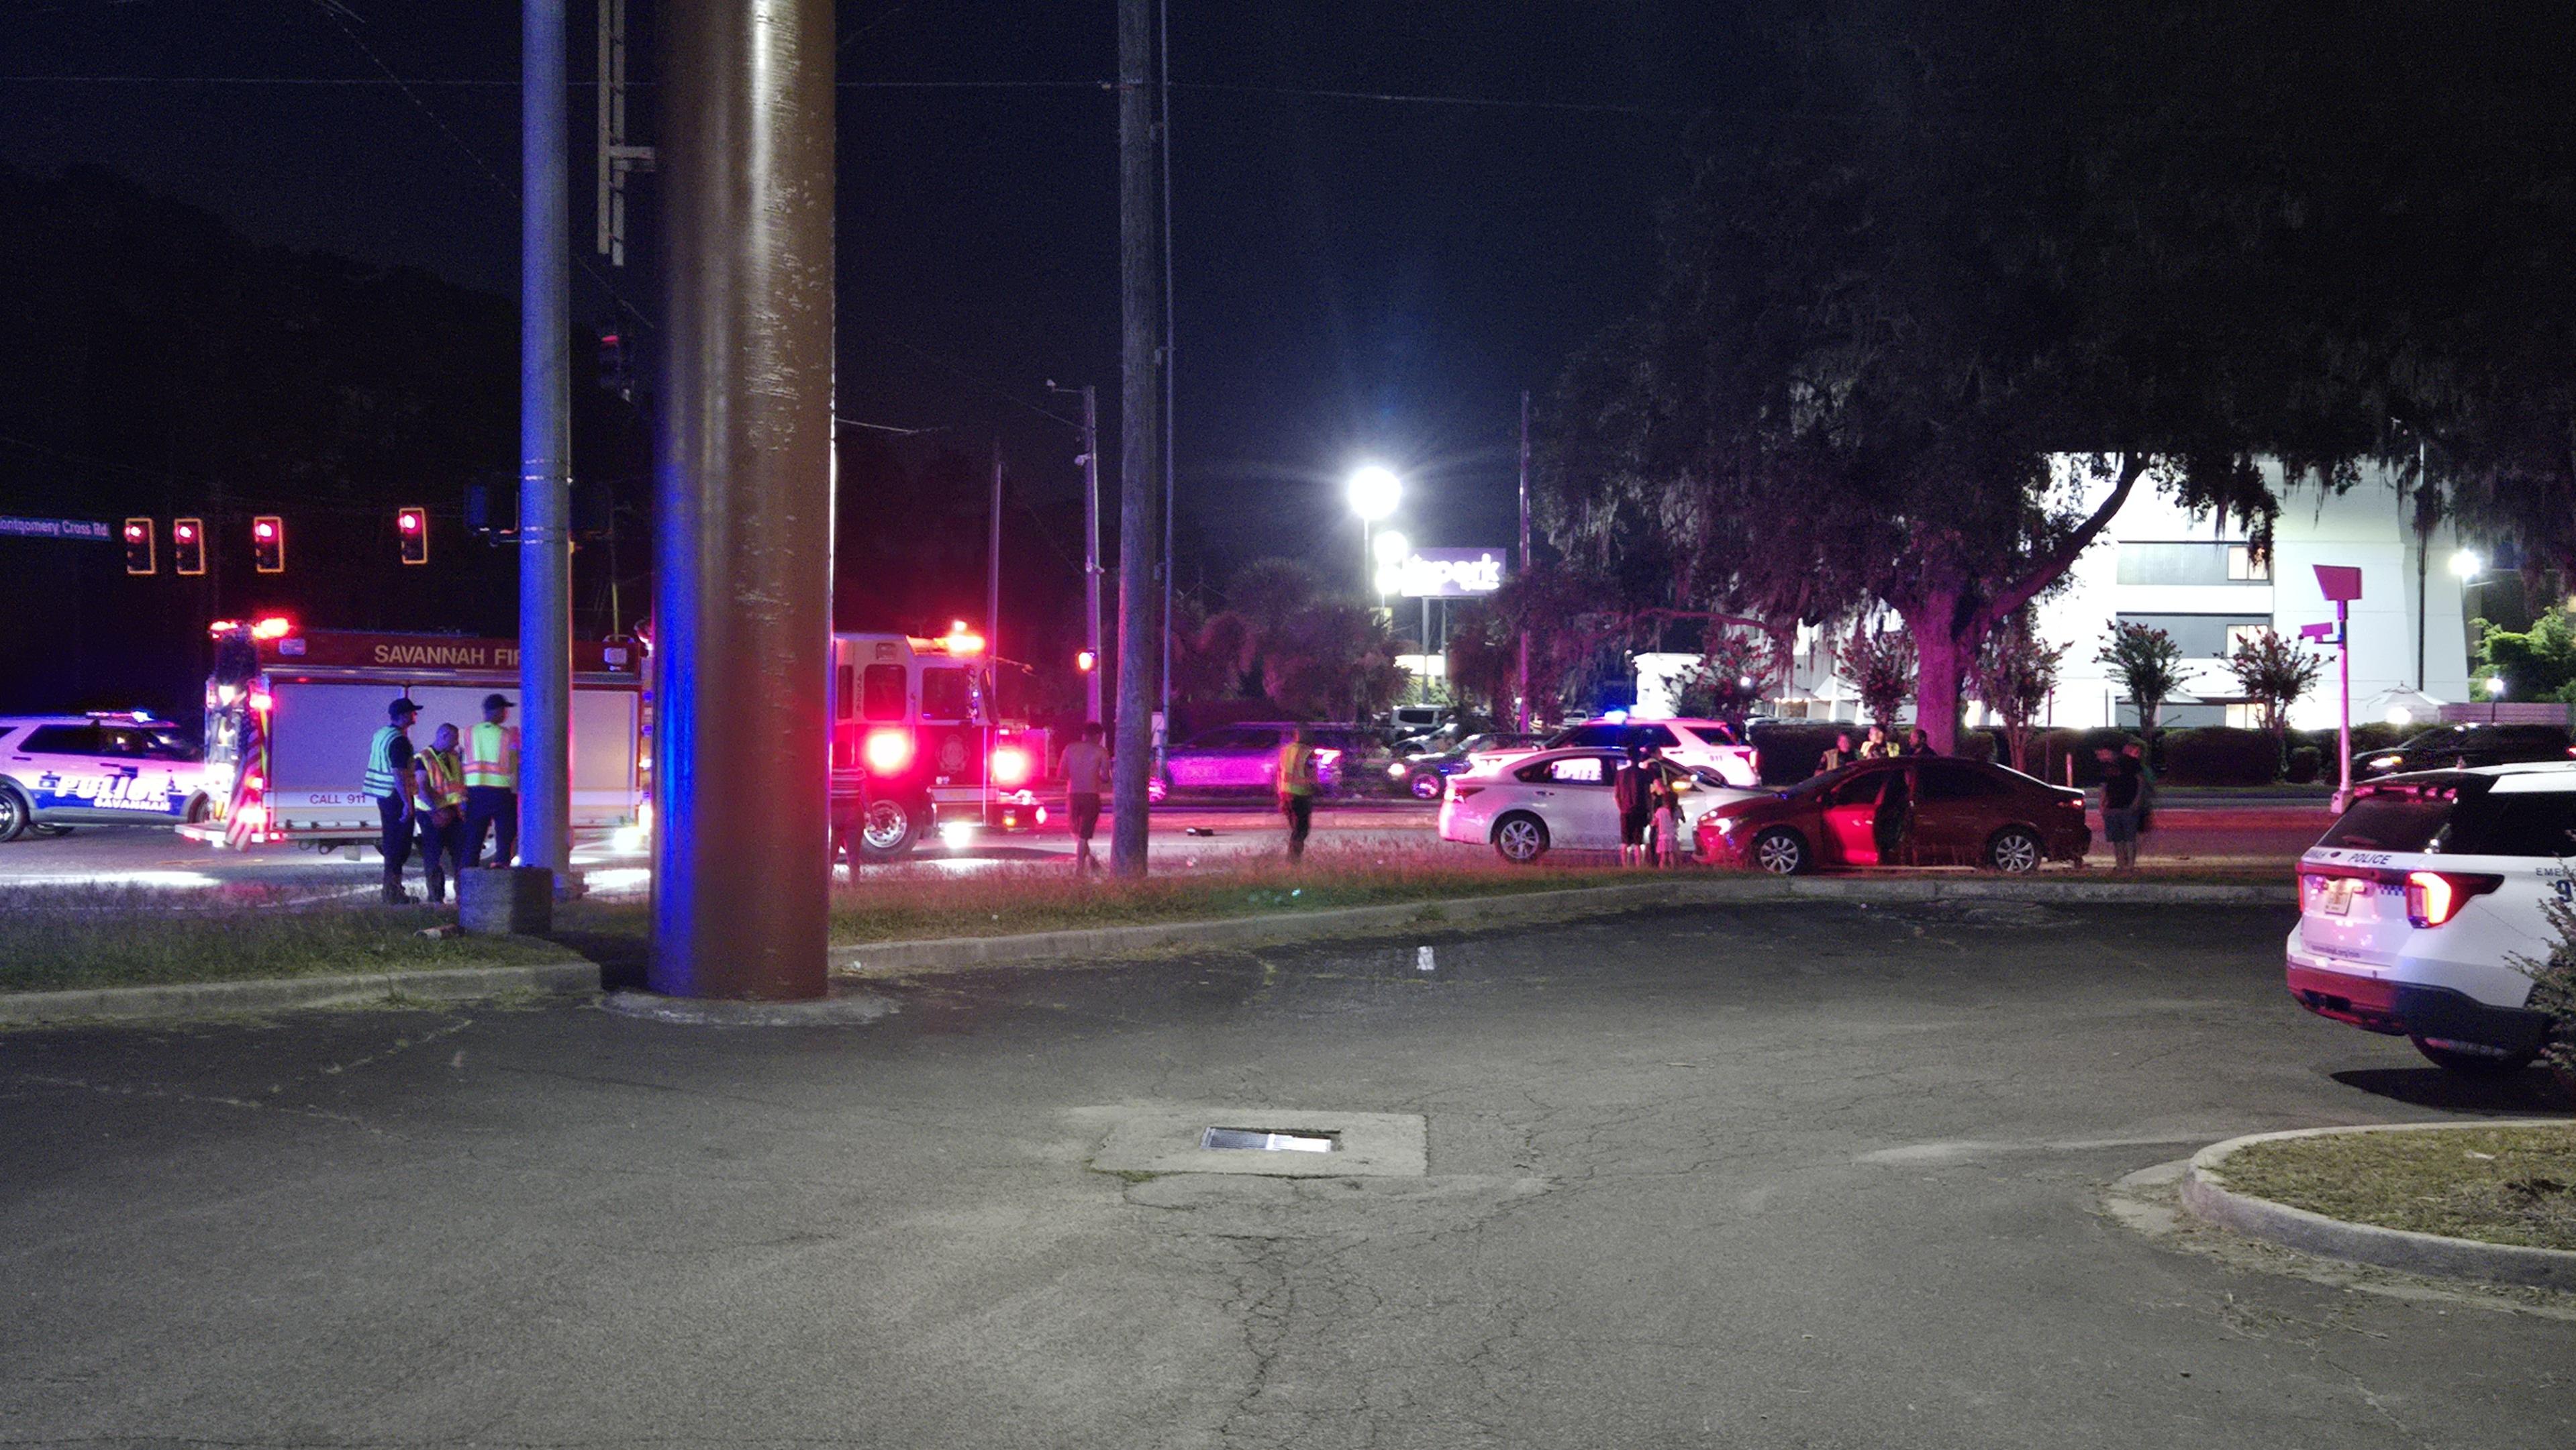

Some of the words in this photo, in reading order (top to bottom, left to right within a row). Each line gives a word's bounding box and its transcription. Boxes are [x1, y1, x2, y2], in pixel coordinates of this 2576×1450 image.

[0, 519, 60, 535] ontgomery
[62, 520, 91, 535] Cross
[93, 522, 108, 536] Rd
[375, 645, 485, 665] SAVANNAH
[309, 794, 342, 805] CALL
[348, 794, 366, 804] 911
[2348, 853, 2391, 865] POLICE
